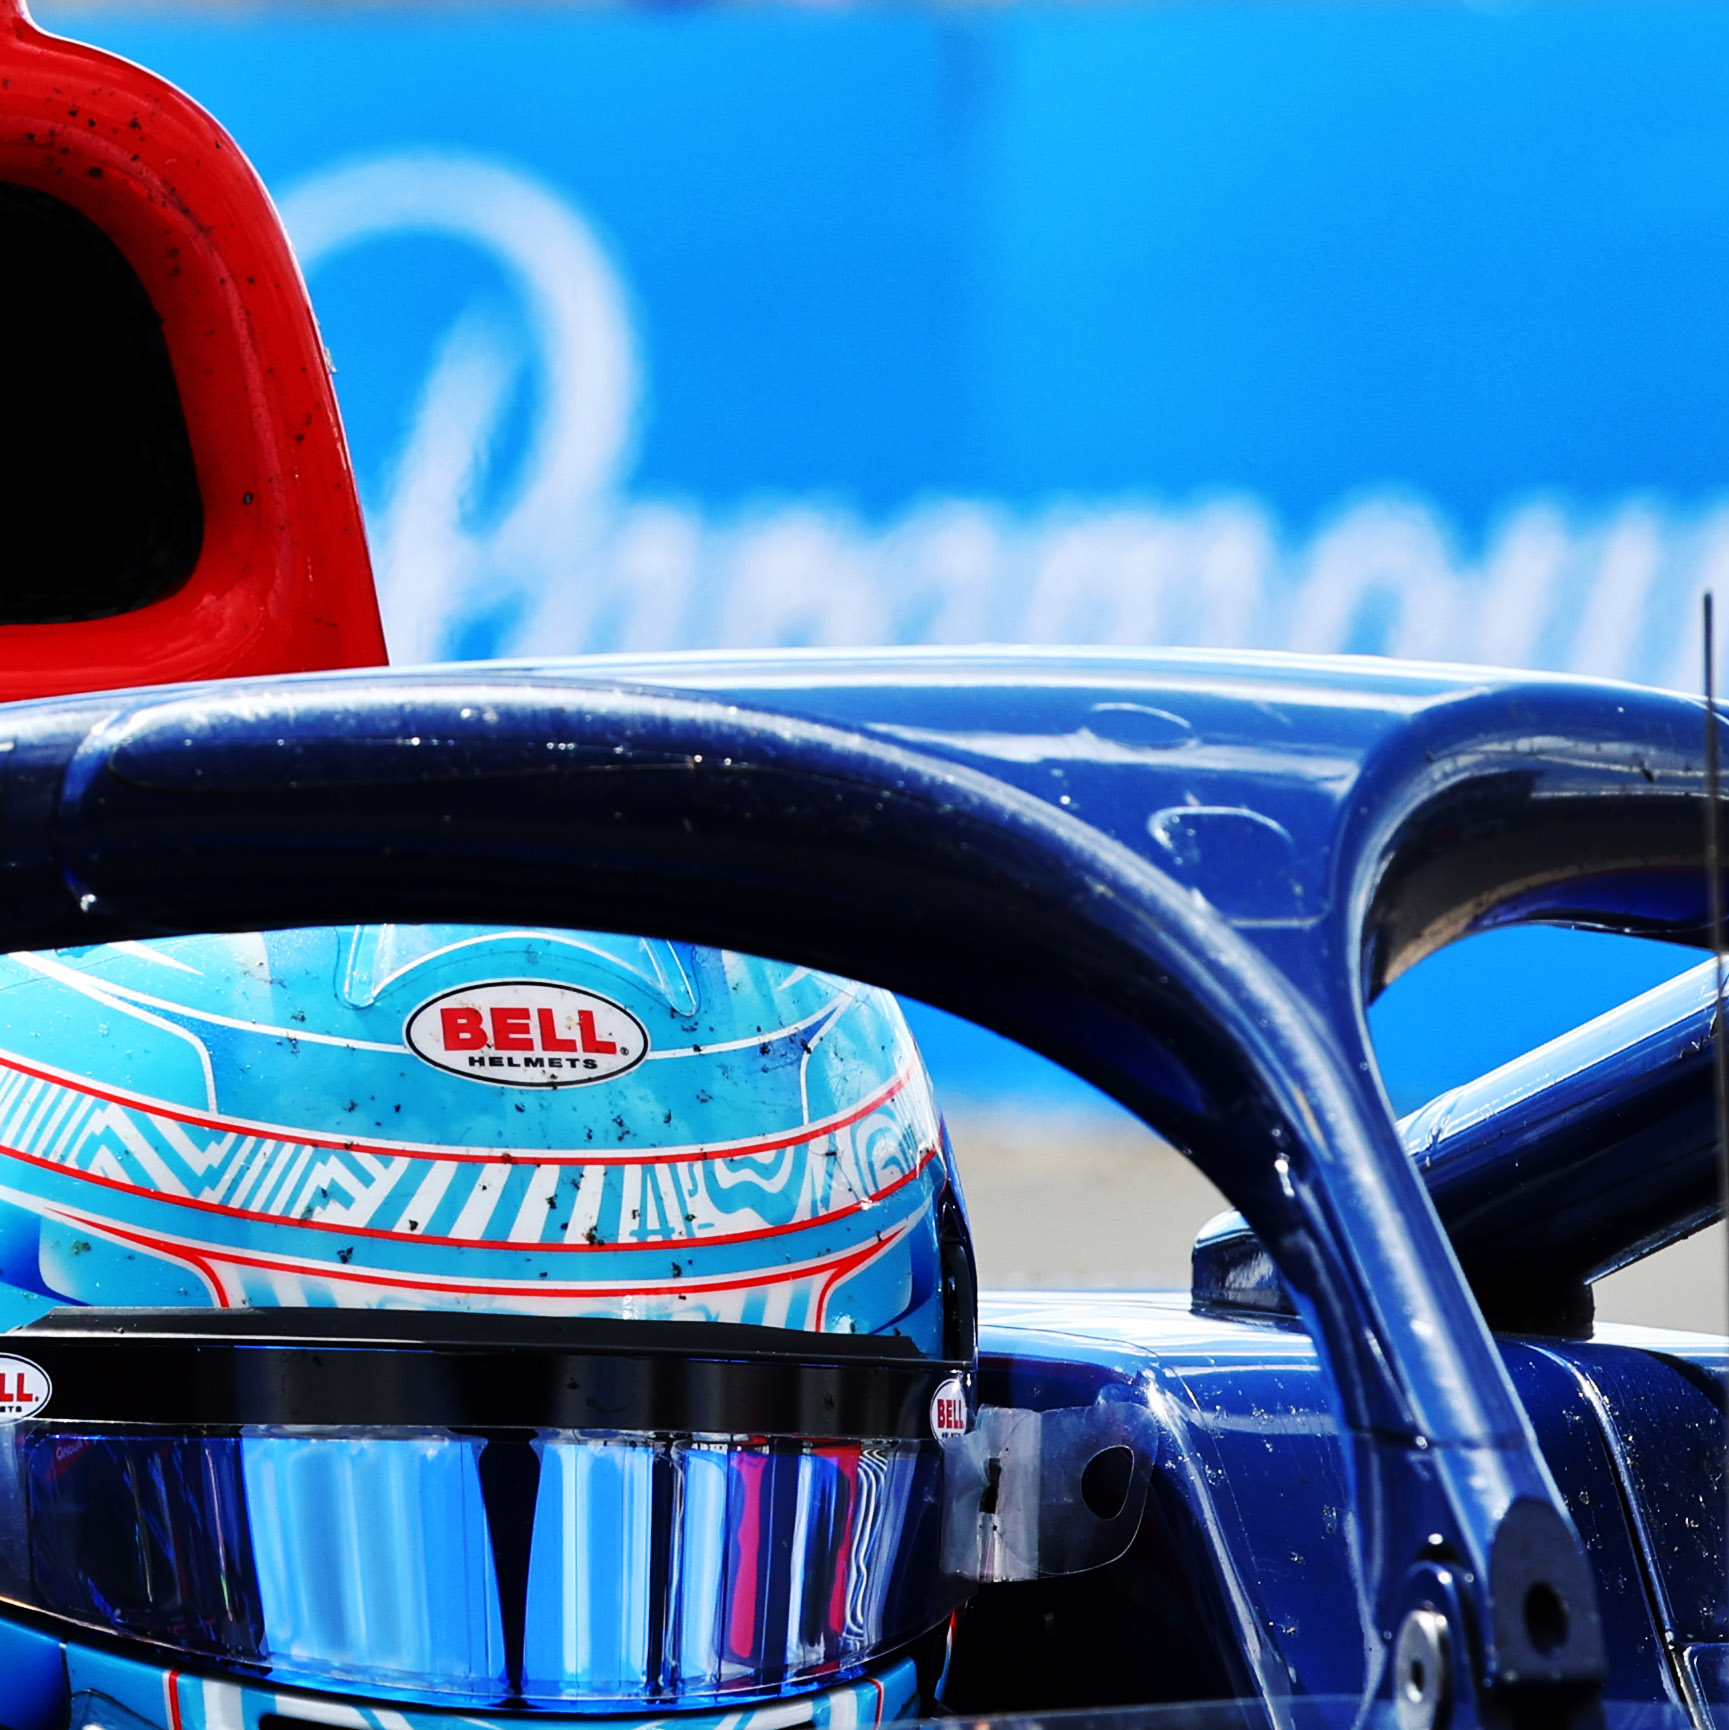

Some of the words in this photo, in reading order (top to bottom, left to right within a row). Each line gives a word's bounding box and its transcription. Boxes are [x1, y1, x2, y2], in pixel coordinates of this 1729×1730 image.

[440, 1006, 618, 1055] BELL
[468, 1056, 598, 1070] HELMETS
[937, 1398, 965, 1430] BELL
